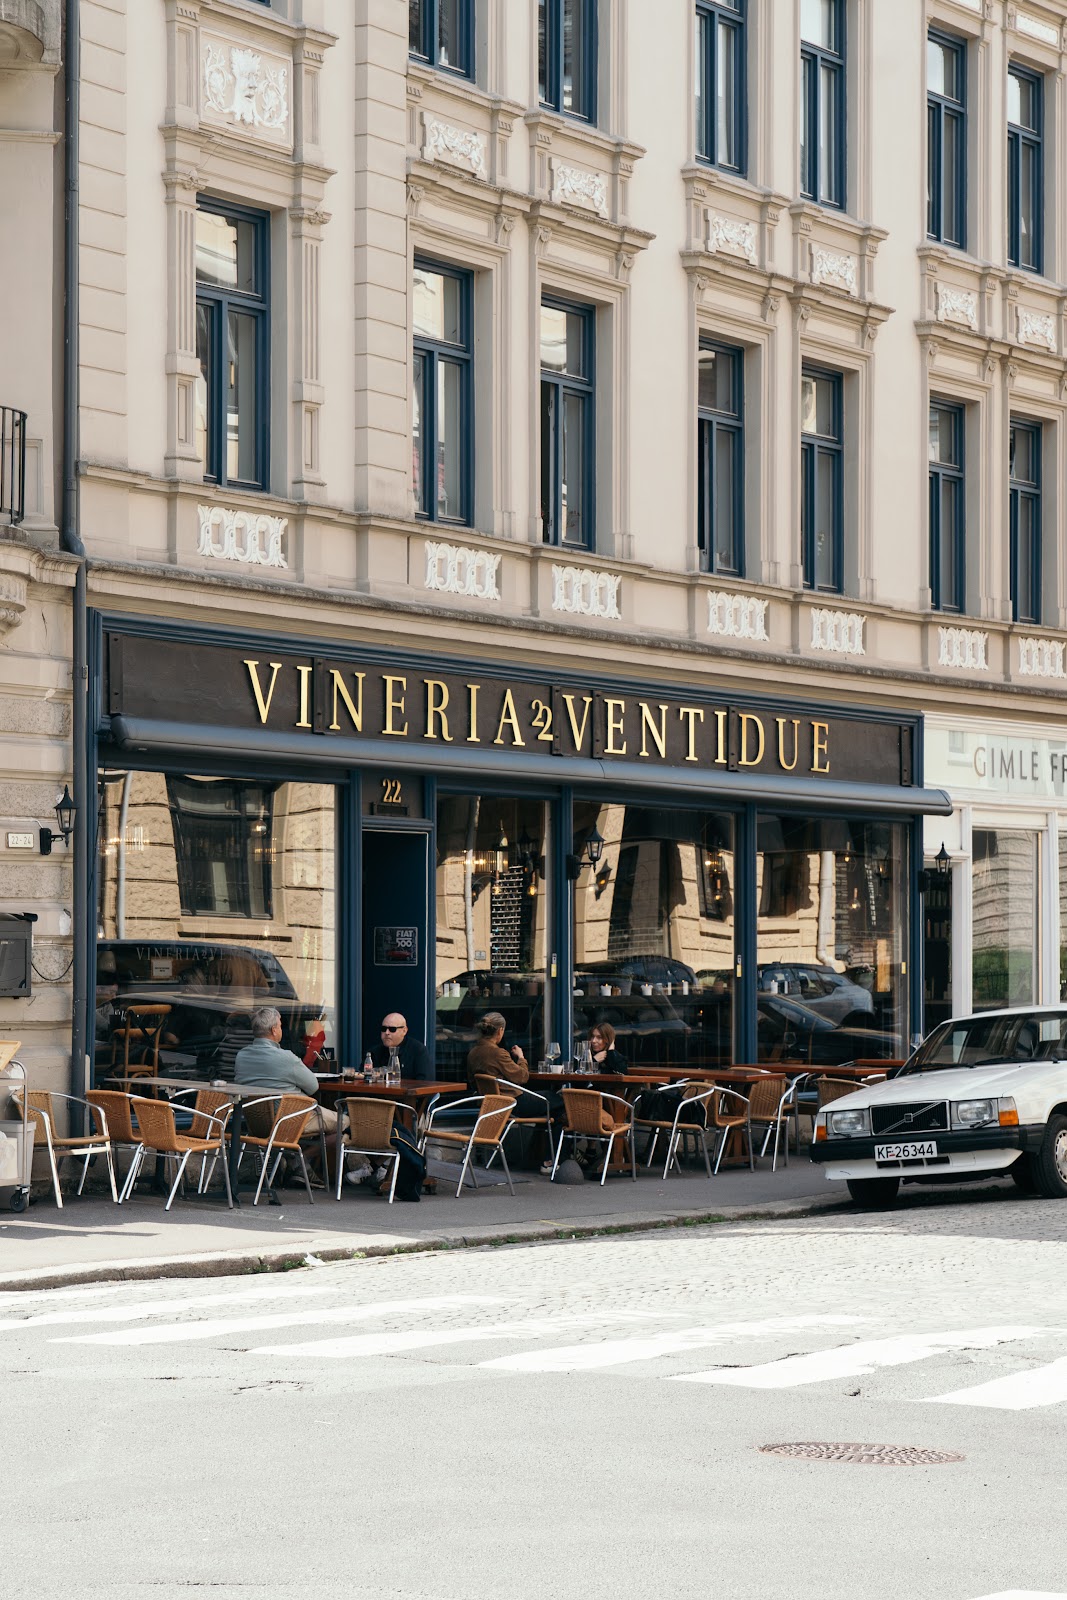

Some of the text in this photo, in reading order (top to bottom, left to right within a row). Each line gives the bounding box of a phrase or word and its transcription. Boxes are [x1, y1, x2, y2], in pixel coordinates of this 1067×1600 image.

[243, 659, 526, 747] VINERIA
[562, 693, 831, 774] VENTIDUE
[973, 747, 1039, 781] GIMLE
[382, 778, 402, 803] 22
[396, 930, 414, 938] FIAT
